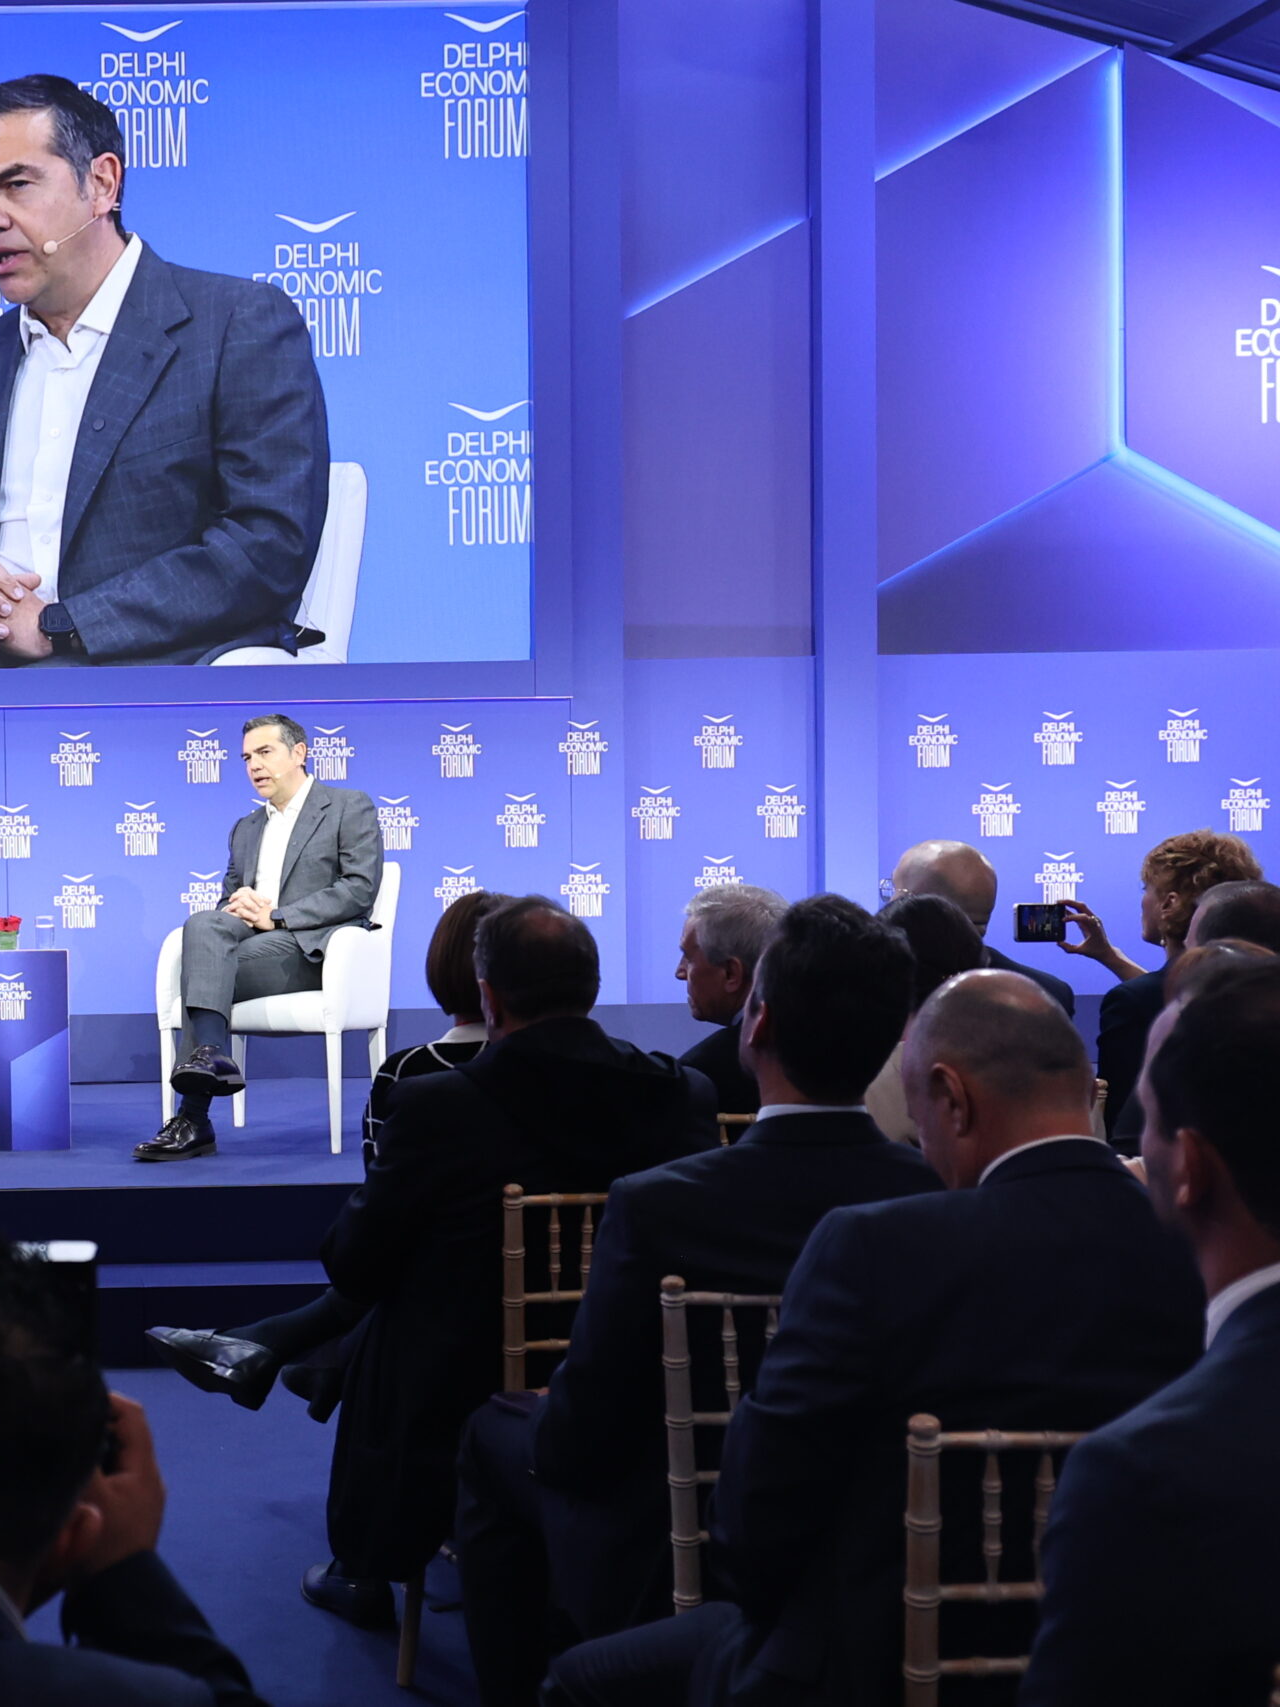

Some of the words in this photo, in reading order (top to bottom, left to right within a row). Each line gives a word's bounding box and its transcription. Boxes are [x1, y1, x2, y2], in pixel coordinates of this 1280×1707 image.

[443, 41, 527, 69] DELPHI
[100, 51, 185, 78] DELPHI
[420, 69, 528, 97] ECONOM
[444, 97, 528, 159] FORUM
[275, 242, 359, 269] DELPHI
[448, 430, 531, 457] DELPHI
[425, 458, 531, 485] ECONOM
[449, 484, 531, 546] FORUM
[702, 725, 735, 736] DELPHI
[917, 725, 950, 735] DELPHI
[1042, 722, 1075, 732] DELPHI
[1167, 720, 1200, 730] DELPHI
[440, 734, 473, 745] DELPHI
[567, 732, 600, 742] DELPHI
[693, 734, 743, 747] ECONOMIC
[908, 734, 958, 746] ECONOMIC
[1034, 731, 1083, 743] ECONOMIC
[1158, 729, 1208, 740] ECONOMIC
[59, 743, 92, 753] DELPHI
[186, 740, 219, 750] DELPHI
[313, 737, 346, 747] DELPHI
[558, 741, 608, 753] ECONOMIC
[178, 749, 228, 761] ECONOMIC
[307, 746, 354, 758] ECONOMIC
[432, 744, 481, 755] ECONOMIC
[1042, 742, 1075, 765] FORUM
[1167, 739, 1200, 763] FORUM
[51, 752, 100, 764] ECONOMIC
[702, 745, 735, 769] FORUM
[917, 744, 950, 768] FORUM
[314, 757, 346, 781] FORUM
[441, 754, 474, 778] FORUM
[567, 751, 600, 776] FORUM
[60, 762, 92, 787] FORUM
[187, 760, 220, 784] FORUM
[765, 795, 798, 805] DELPHI
[980, 794, 1013, 804] DELPHI
[1105, 791, 1138, 801] DELPHI
[1229, 789, 1262, 799] DELPHI
[640, 797, 673, 807] DELPHI
[1096, 800, 1146, 812] ECONOMIC
[1221, 798, 1270, 809] ECONOMIC
[378, 806, 411, 817] DELPHI
[505, 804, 538, 814] DELPHI
[631, 806, 681, 818] ECONOMIC
[756, 804, 806, 816] ECONOMIC
[972, 803, 1021, 814] ECONOMIC
[124, 813, 157, 823] DELPHI
[496, 813, 546, 825] ECONOMIC
[1105, 811, 1138, 834] FORUM
[1230, 808, 1262, 832] FORUM
[116, 822, 165, 833] ECONOMIC
[640, 816, 673, 840] FORUM
[765, 814, 798, 839] FORUM
[980, 813, 1013, 837] FORUM
[505, 824, 538, 848] FORUM
[125, 832, 158, 856] FORUM
[702, 866, 736, 877] DELPHI
[1043, 863, 1076, 873] DELPHI
[442, 876, 475, 887] DELPHI
[569, 873, 602, 884] DELPHI
[1034, 872, 1084, 884] ECONOMIC
[62, 885, 95, 895] DELPHI
[189, 881, 222, 892] DELPHI
[560, 882, 610, 895] ECONOMIC
[54, 894, 103, 906] ECONOMIC
[569, 893, 602, 917] FORUM
[63, 905, 95, 929] FORUM
